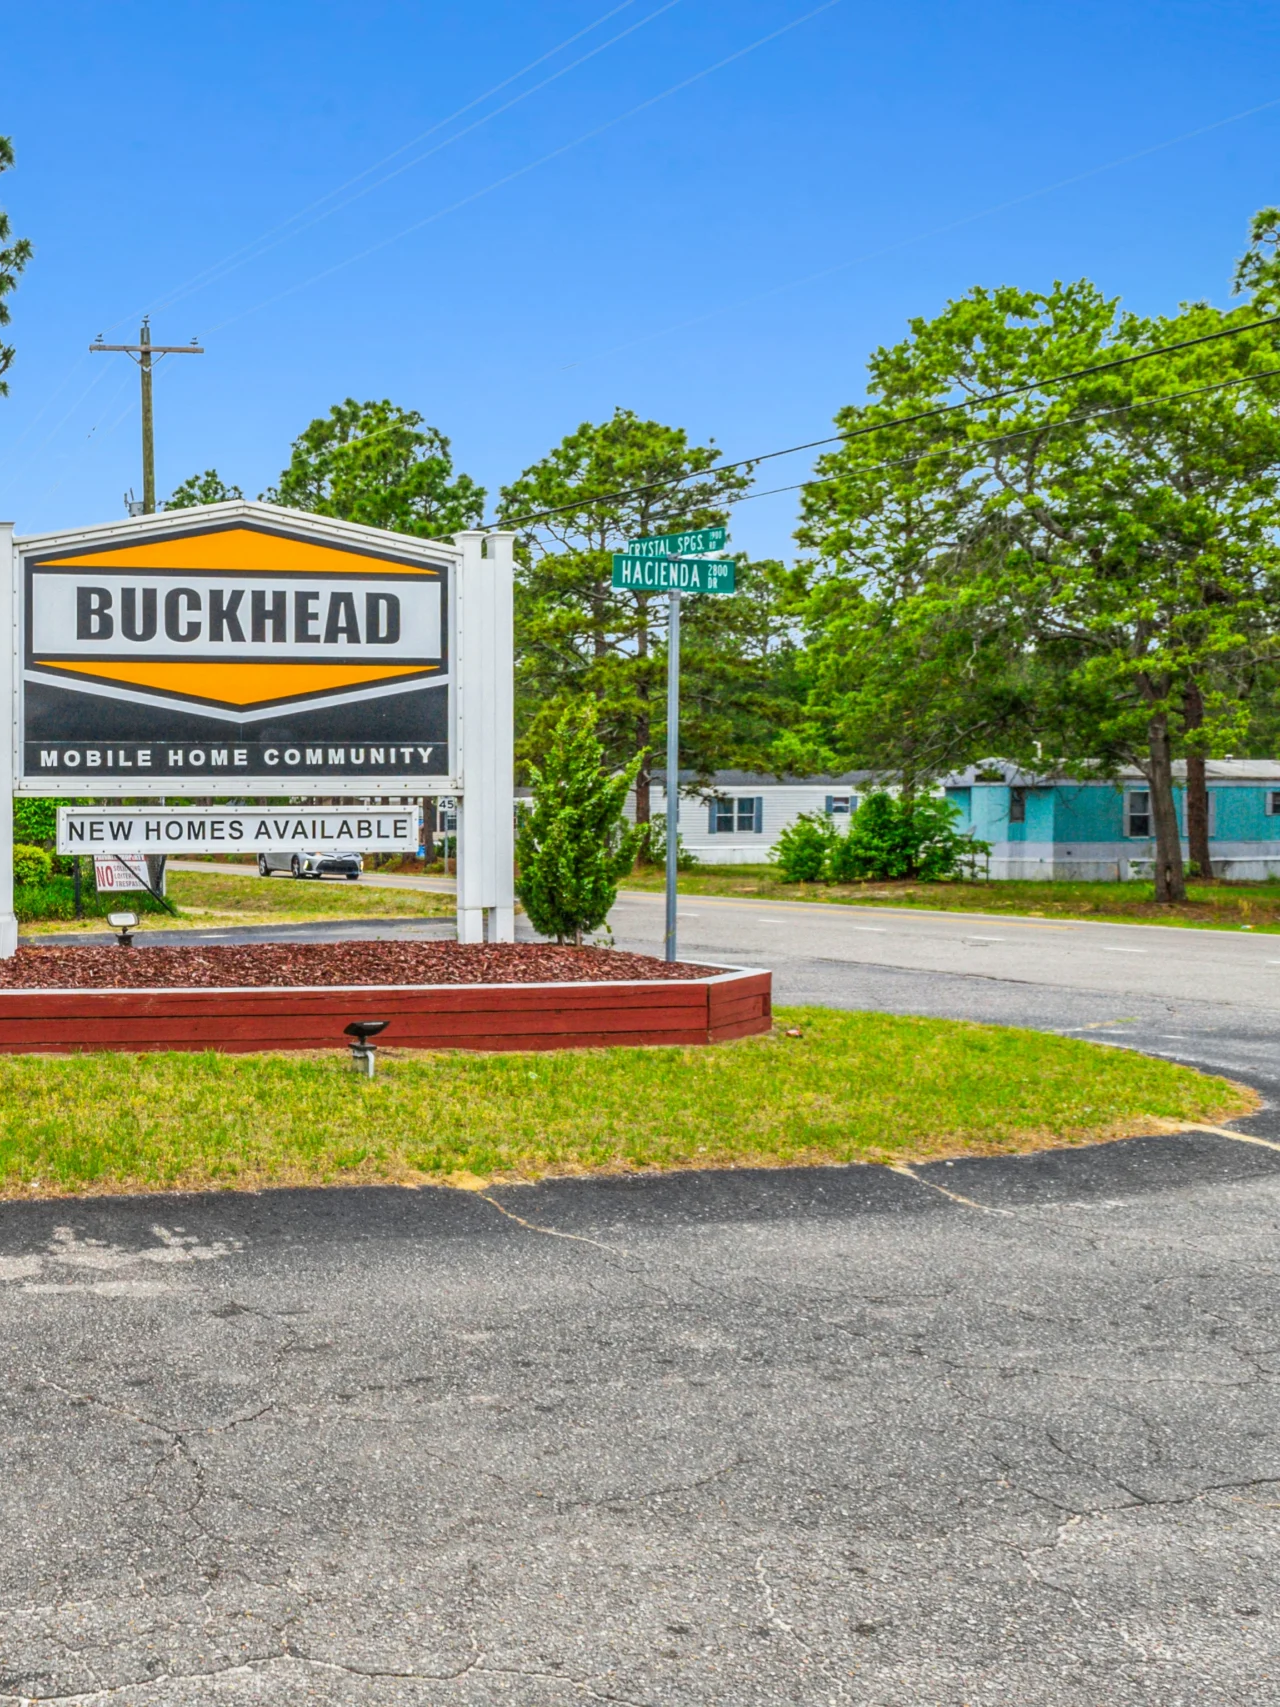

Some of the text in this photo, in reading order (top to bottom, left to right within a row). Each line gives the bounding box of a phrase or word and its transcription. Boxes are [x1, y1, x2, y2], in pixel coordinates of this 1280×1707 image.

[629, 534, 705, 557] CRYSTAL SPGS.
[709, 541, 716, 550] RD
[621, 559, 701, 588] HACIENDA
[708, 564, 728, 577] 2800
[708, 577, 718, 589] DR
[75, 586, 401, 645] BUCKHEAD
[39, 746, 435, 768] MOBILE HOME COMMUNITY
[438, 800, 454, 809] 45
[67, 818, 409, 842] NEW HOMES AVAILABLE
[96, 865, 114, 887] NO
